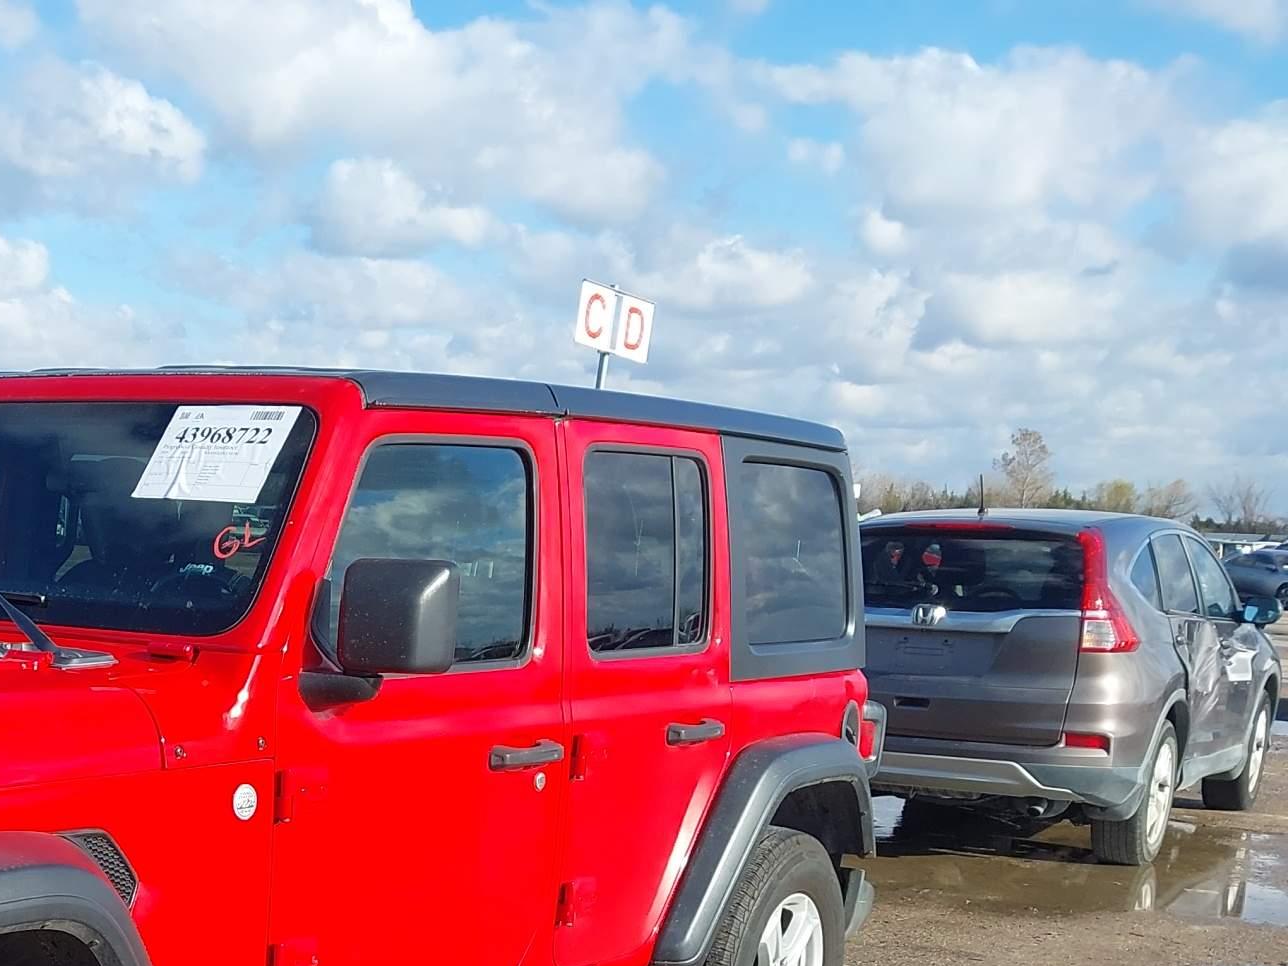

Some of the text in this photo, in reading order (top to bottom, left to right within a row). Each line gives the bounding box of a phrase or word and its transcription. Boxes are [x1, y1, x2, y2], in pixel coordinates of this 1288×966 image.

[585, 293, 644, 350] C D
[175, 426, 273, 444] 43968722
